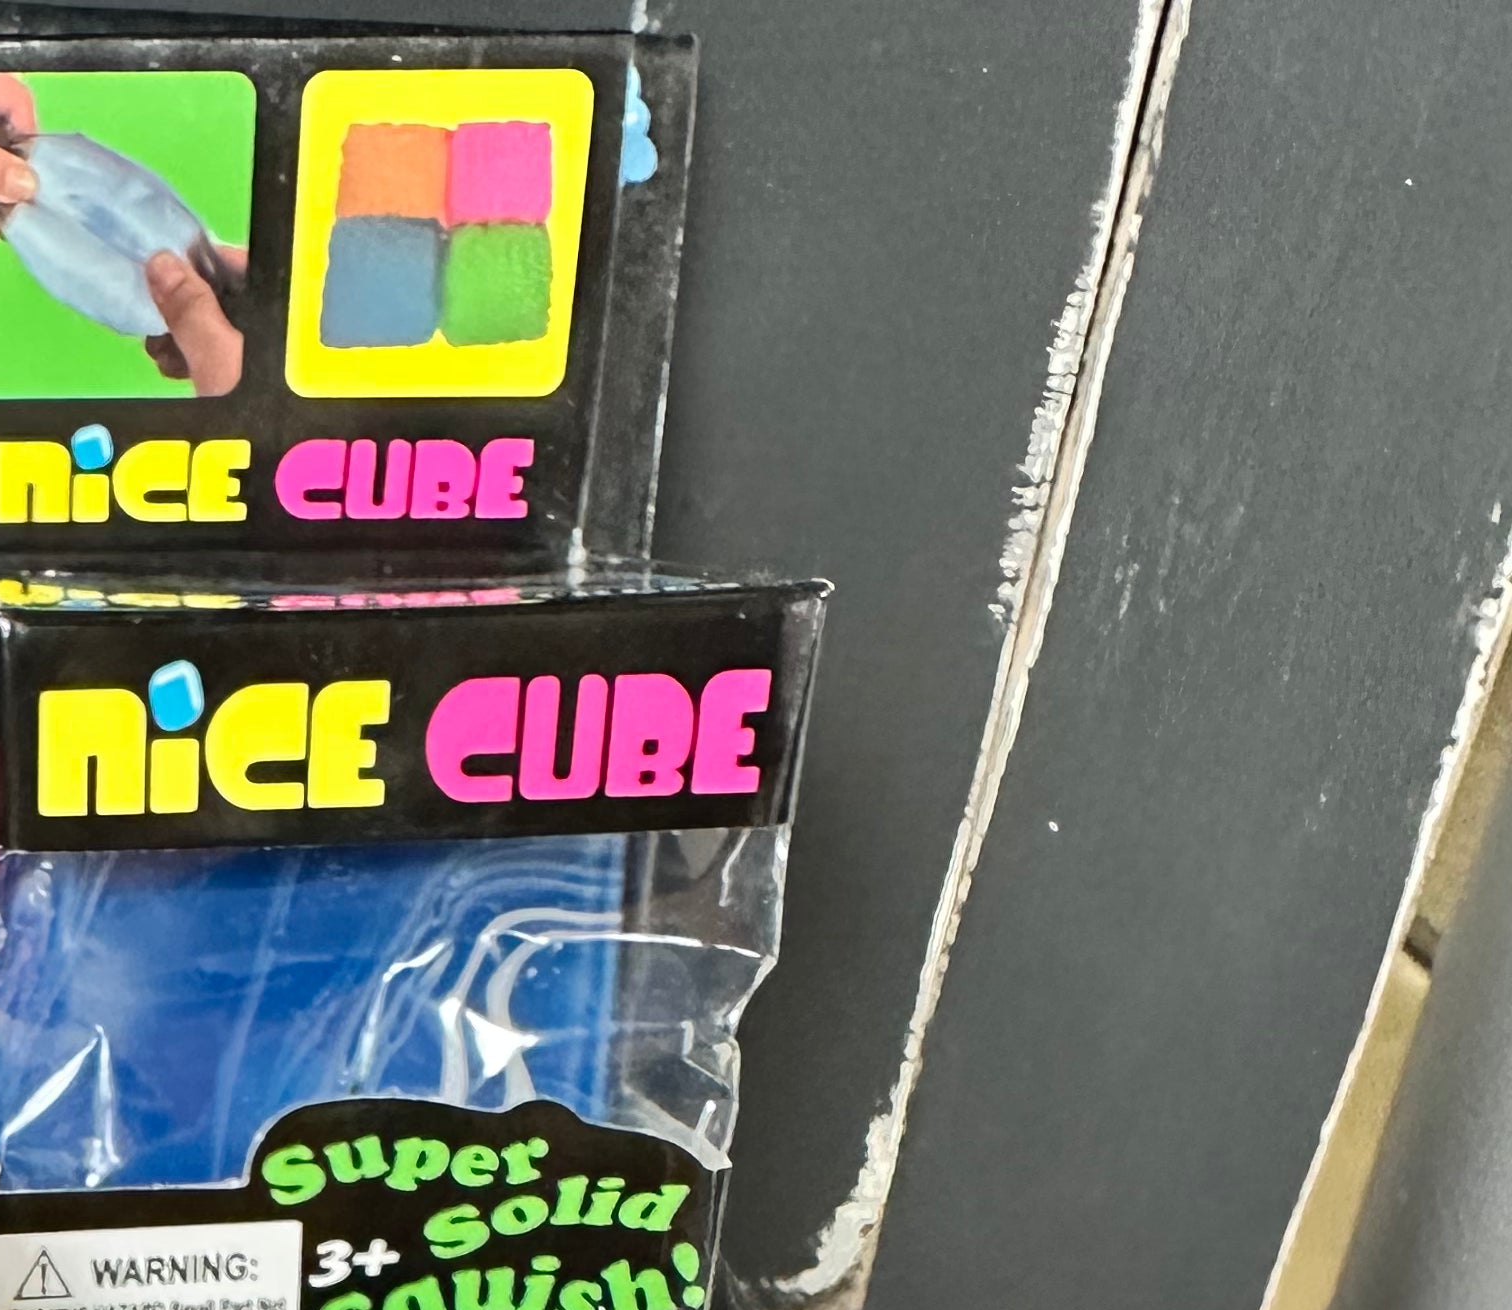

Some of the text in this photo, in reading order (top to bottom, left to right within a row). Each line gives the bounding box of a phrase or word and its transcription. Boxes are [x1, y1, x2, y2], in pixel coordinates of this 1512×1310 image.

[275, 438, 535, 521] CUBE
[424, 669, 773, 803] CUBE
[261, 1134, 550, 1206] Super
[423, 1174, 691, 1260] Solid
[90, 1252, 259, 1288] WARNING:
[308, 1237, 402, 1289] 3+
